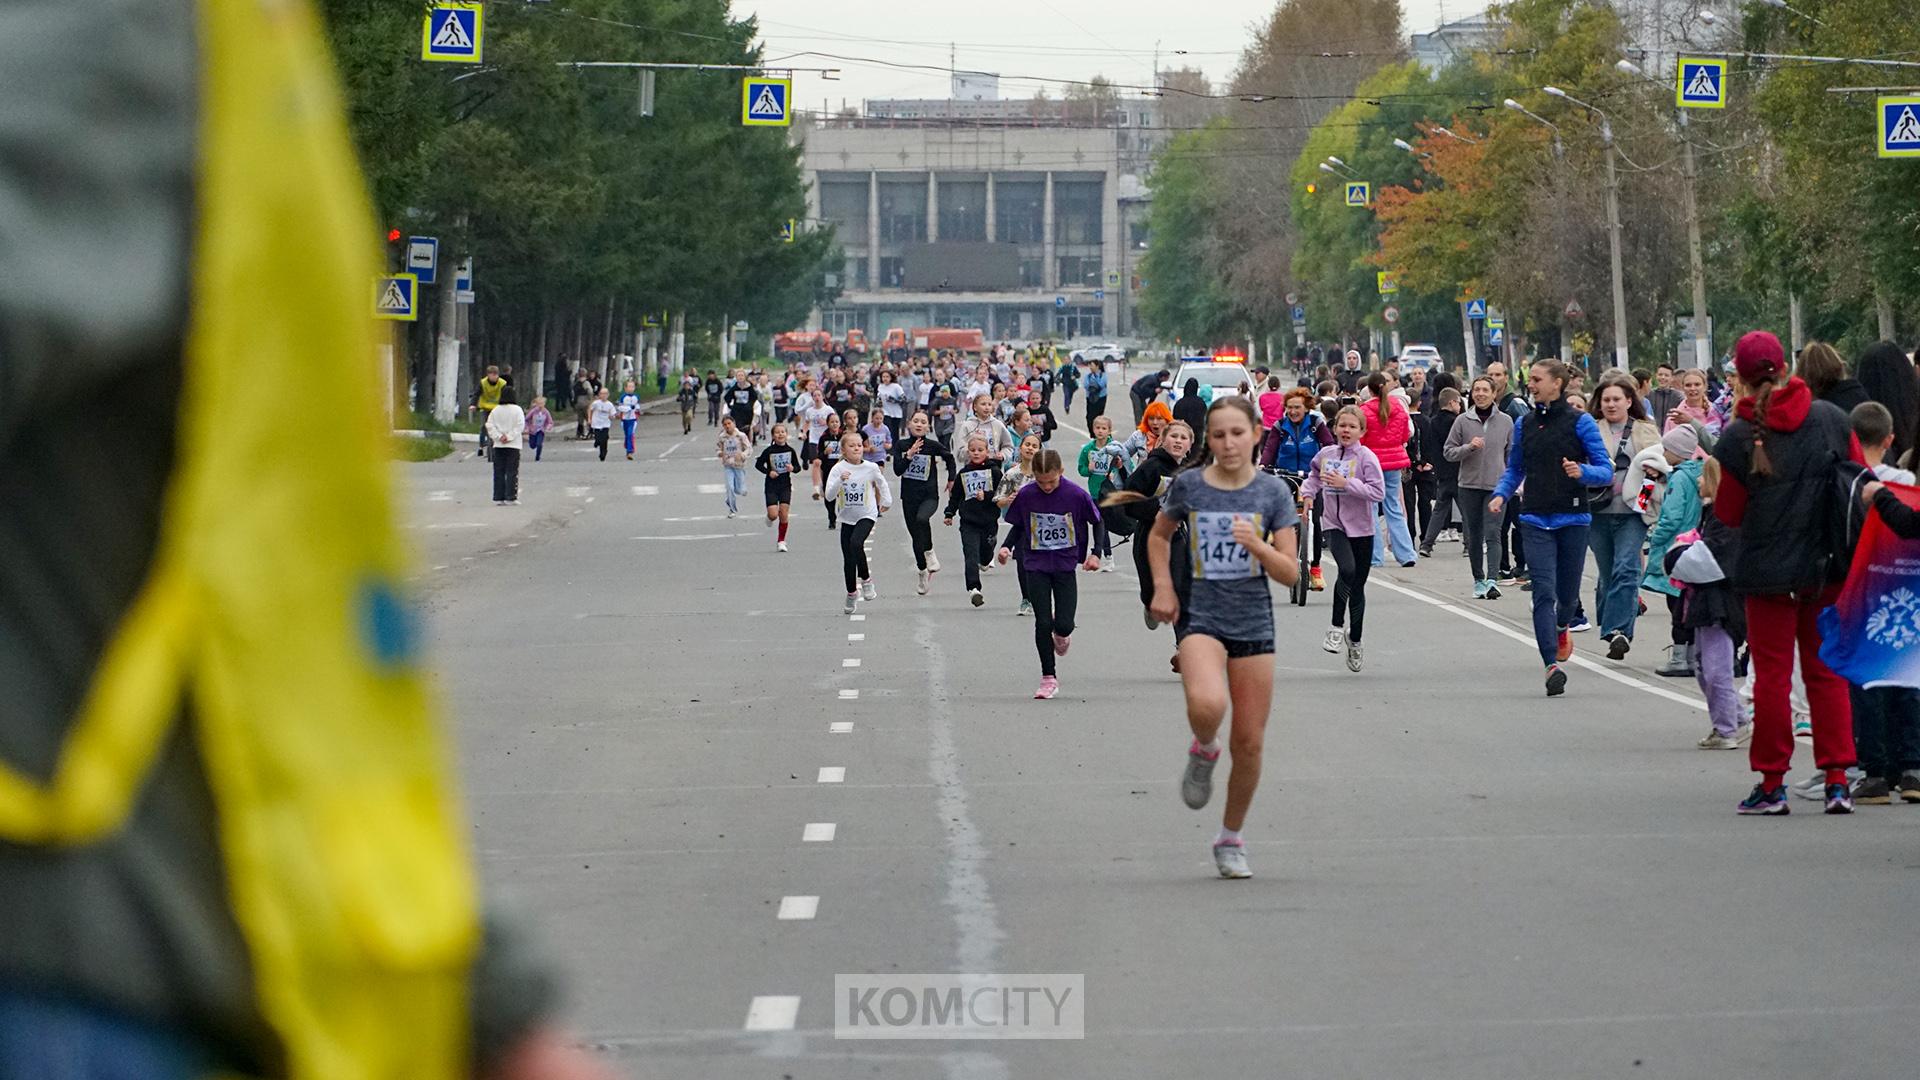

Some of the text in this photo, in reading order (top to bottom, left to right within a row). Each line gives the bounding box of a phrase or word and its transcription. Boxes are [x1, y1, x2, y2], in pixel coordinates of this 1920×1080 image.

[967, 481, 986, 492] 1147
[845, 493, 864, 502] 1991
[1038, 528, 1067, 541] 1263
[1200, 541, 1249, 563] 1474
